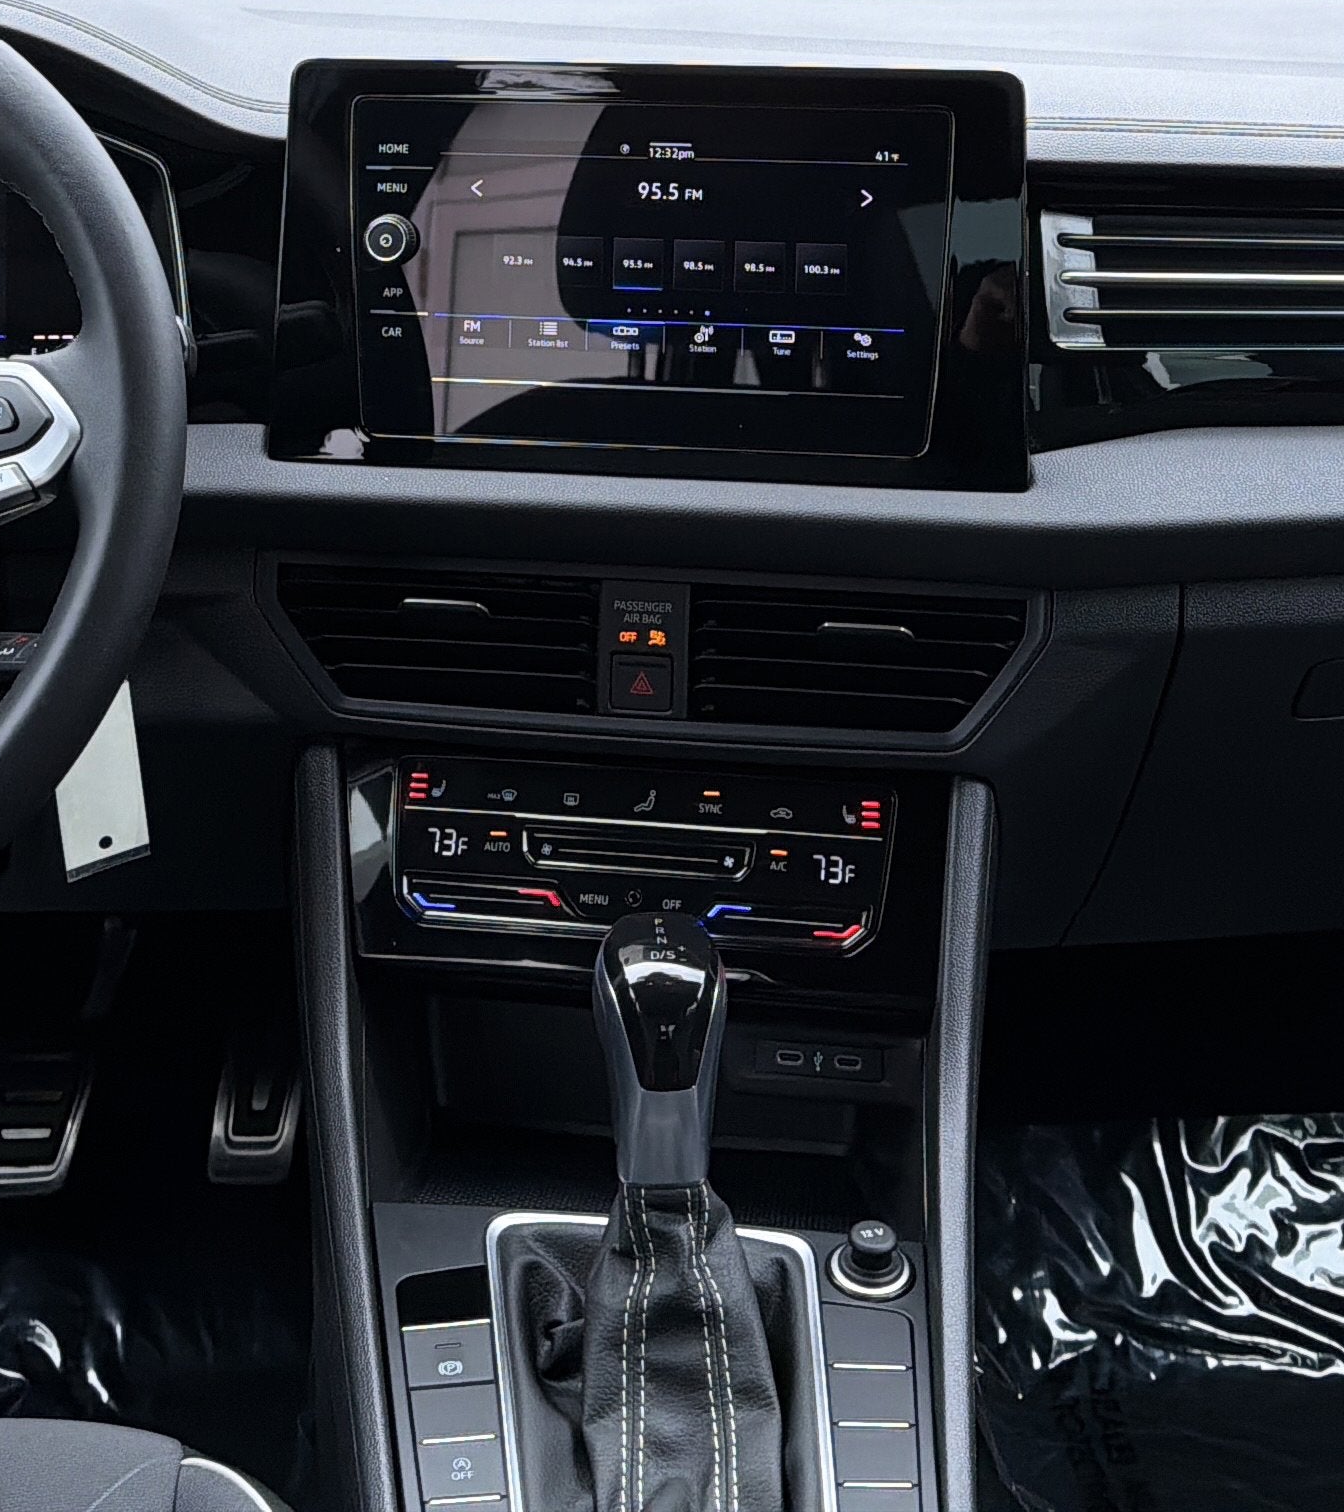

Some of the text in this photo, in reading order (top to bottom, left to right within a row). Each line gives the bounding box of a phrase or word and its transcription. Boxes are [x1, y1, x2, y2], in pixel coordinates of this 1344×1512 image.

[378, 143, 409, 155] HOME
[648, 147, 695, 160] 12:32pm
[874, 151, 889, 163] 41
[376, 182, 408, 194] MENU
[637, 181, 704, 202] 95.5 FM
[502, 254, 523, 266] 92.3
[622, 258, 643, 269] 95.5
[683, 261, 704, 272] 98.5
[744, 262, 765, 274] 98.5
[803, 264, 830, 276] 100.3
[382, 286, 404, 298] APP
[462, 319, 481, 332] FM
[381, 326, 403, 338] CAR
[458, 334, 485, 346] Source
[527, 337, 554, 348] Station
[610, 341, 640, 352] Presets
[688, 342, 717, 354] Station
[772, 346, 791, 357] Tune
[846, 348, 880, 361] Settings
[613, 599, 673, 613] PASSENGER
[622, 612, 662, 625] AIR BAG
[619, 630, 638, 643] OFF
[698, 802, 723, 815] SYNC
[483, 840, 511, 853] AUTO
[769, 860, 788, 872] A/C
[579, 893, 609, 906] MENU
[661, 898, 683, 910] OFF
[655, 926, 666, 935] R
[656, 936, 668, 945] N
[649, 950, 677, 961] D/S
[859, 1229, 874, 1239] 12
[450, 1470, 475, 1481] OFF
